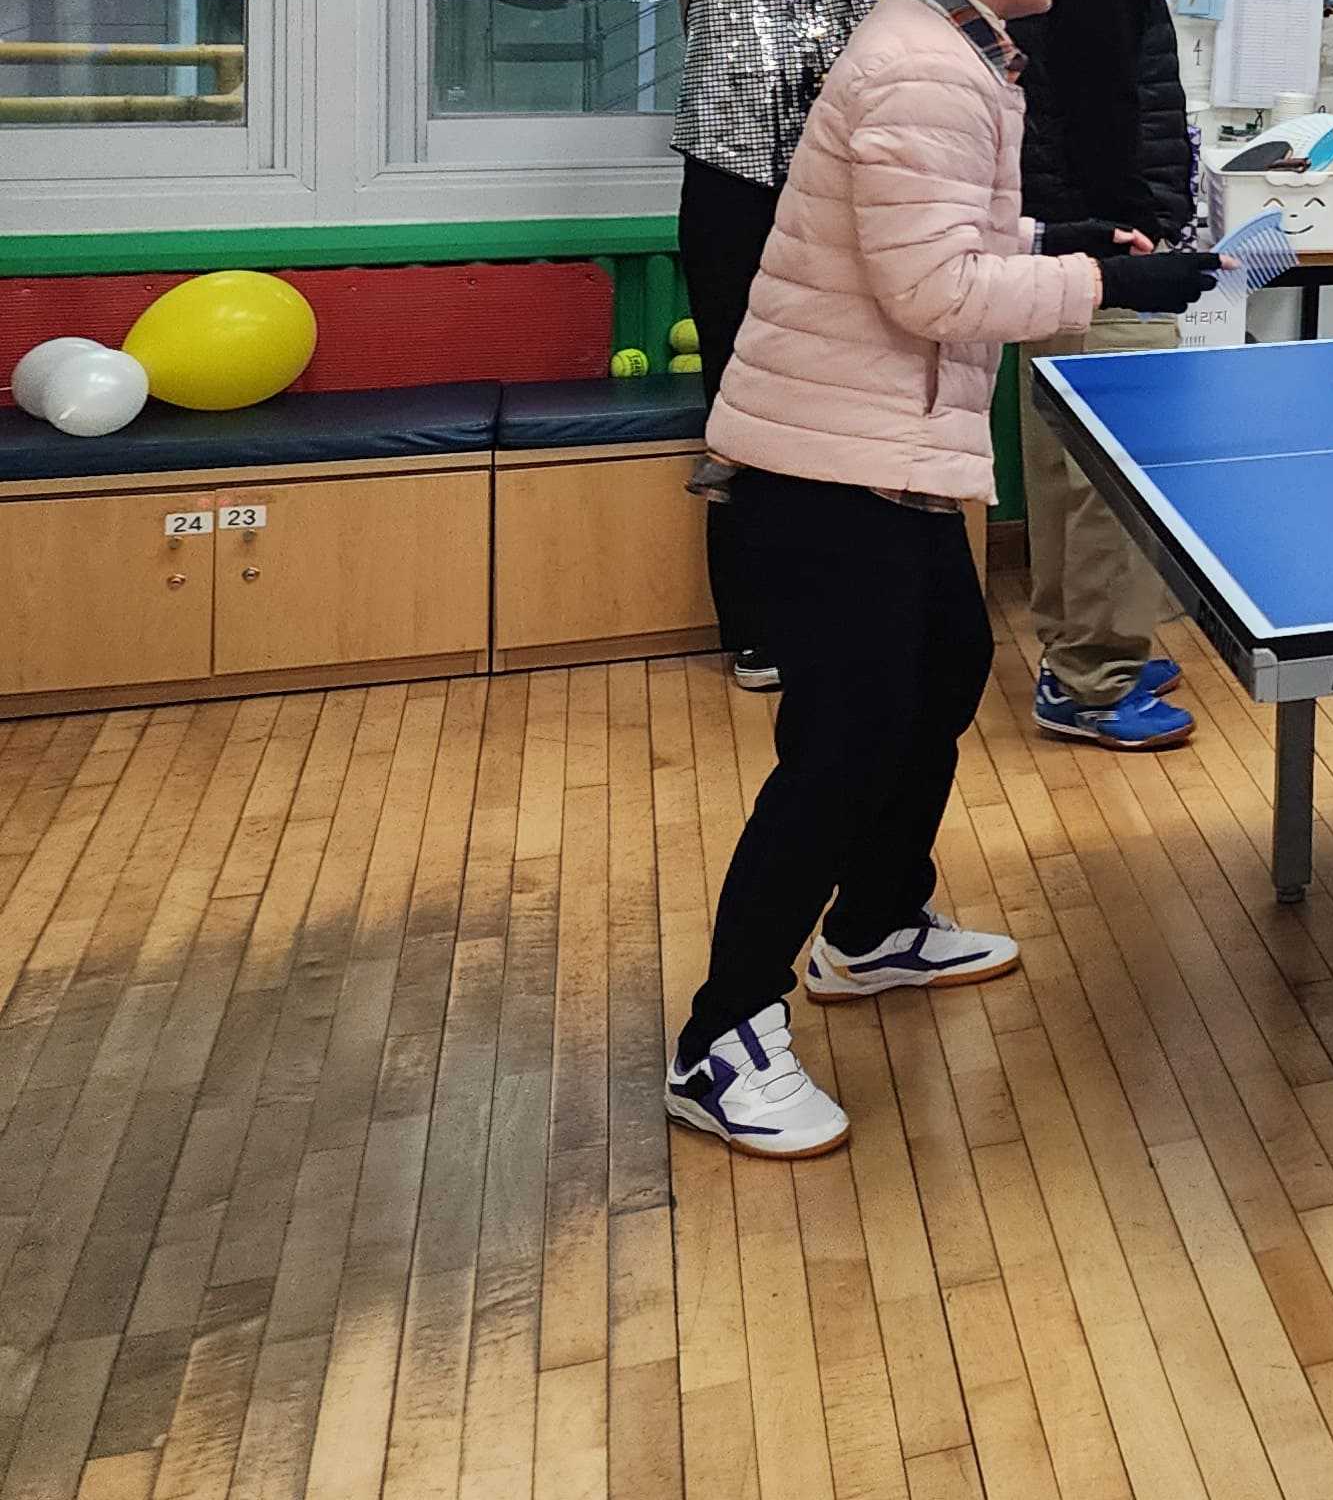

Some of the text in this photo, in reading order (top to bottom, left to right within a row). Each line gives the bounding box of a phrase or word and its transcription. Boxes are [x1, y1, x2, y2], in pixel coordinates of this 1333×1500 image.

[1185, 310, 1228, 325] 버리지
[174, 516, 202, 533] 24
[227, 508, 256, 526] 23
